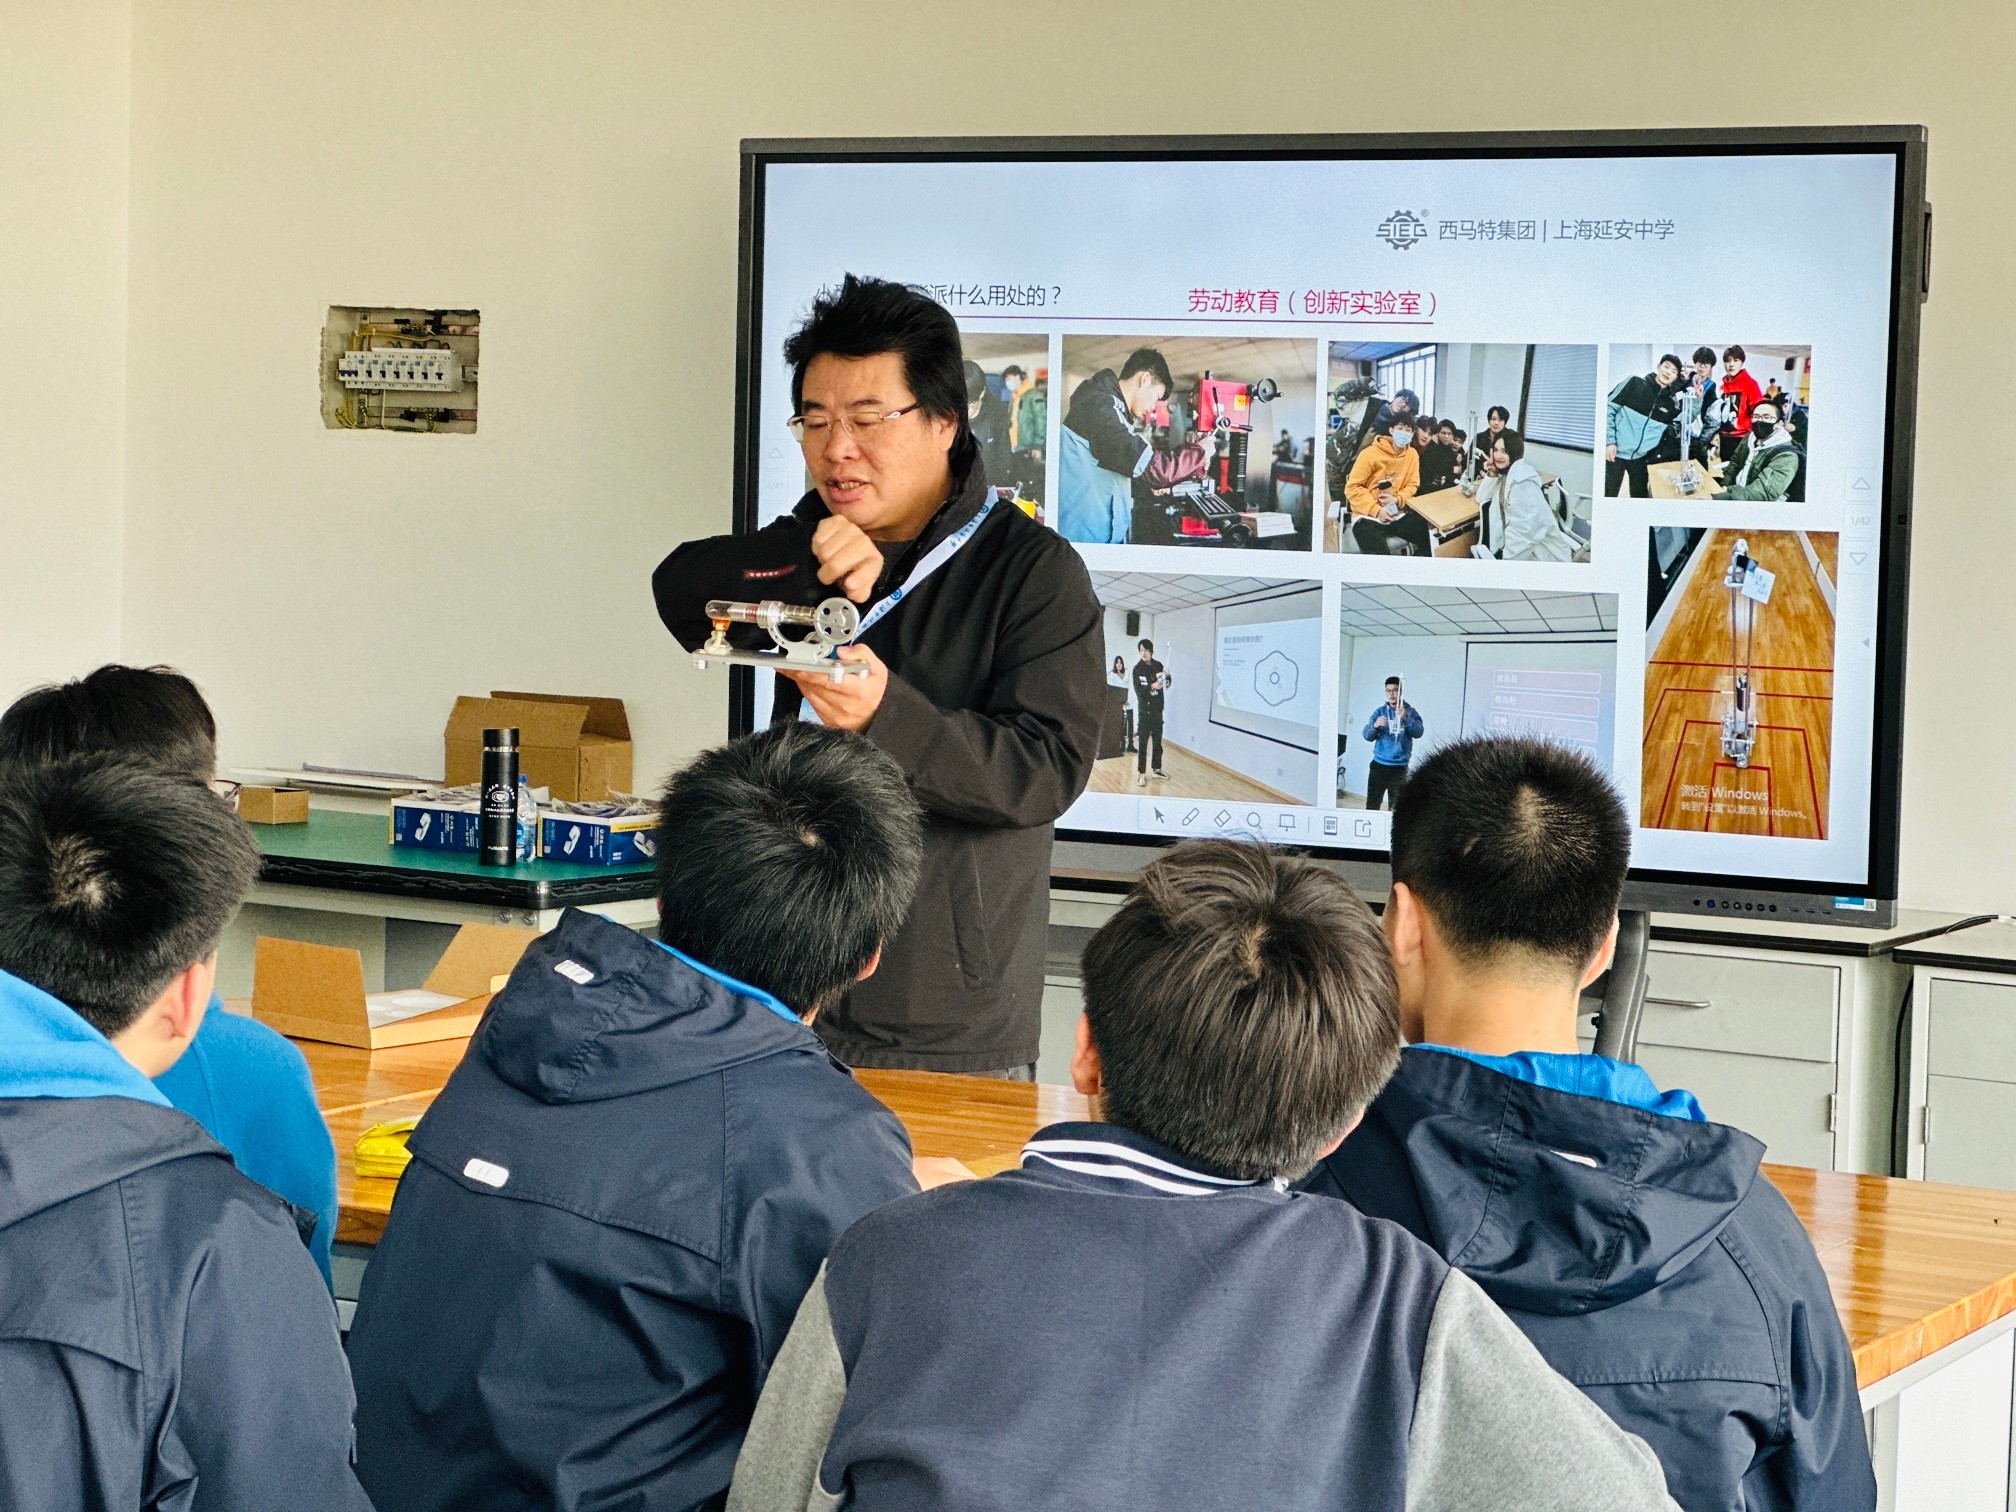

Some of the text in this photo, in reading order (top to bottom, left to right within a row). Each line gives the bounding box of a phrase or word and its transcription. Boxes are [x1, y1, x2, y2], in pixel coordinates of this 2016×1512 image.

[1375, 223, 1428, 238] SIEG
[1681, 784, 1768, 800] 激活 Windows
